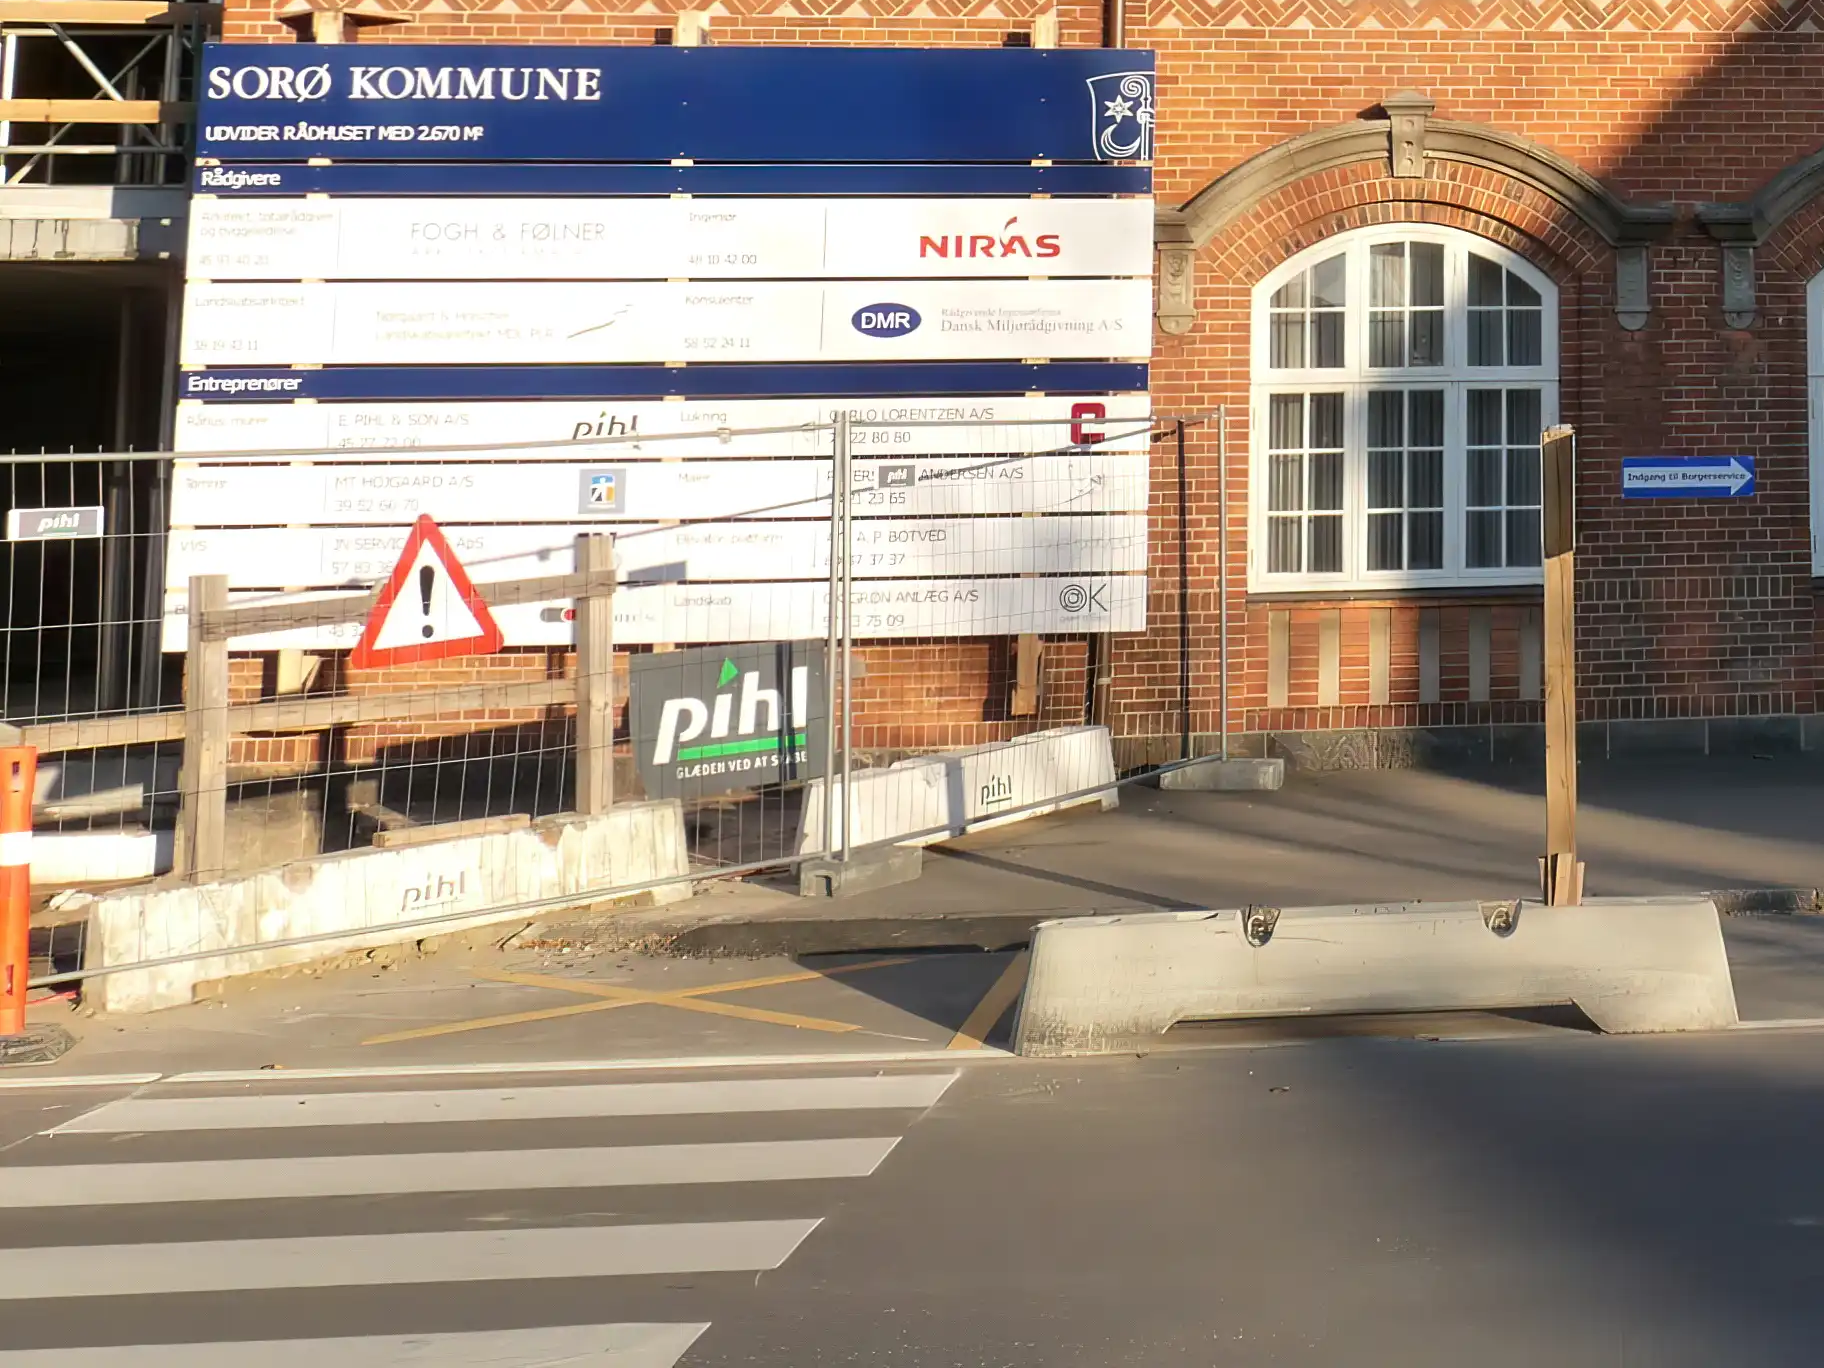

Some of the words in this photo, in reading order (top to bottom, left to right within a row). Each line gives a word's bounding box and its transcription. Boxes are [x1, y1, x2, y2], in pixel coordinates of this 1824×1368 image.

[208, 64, 332, 103] SORØ
[349, 66, 602, 101] KOMMUNE
[205, 126, 280, 142] UDVIDER
[283, 121, 375, 142] RÅDHUSET
[378, 126, 414, 142] MED
[417, 126, 459, 142] 2.670
[201, 168, 281, 189] Rådgivere
[411, 223, 478, 241] FOGH
[492, 222, 507, 241] &
[520, 222, 605, 241] FØLNER
[861, 312, 911, 330] DMR
[941, 320, 982, 333] Dansk
[187, 375, 302, 396] Entreprenører
[444, 414, 470, 426] A/S
[681, 411, 728, 424] Lukning
[882, 408, 964, 421] LORENTZEN
[969, 407, 995, 420] A/S
[573, 411, 638, 440] pihl
[999, 466, 1024, 480] A/S
[1628, 472, 1666, 483] Indgang
[1669, 472, 1679, 482] til
[37, 512, 79, 533] pihl
[889, 529, 947, 543] BOTVED
[895, 590, 949, 603] ANLÆG
[954, 589, 980, 602] A/S
[653, 658, 808, 765] pihl
[677, 764, 725, 780] GLÆDEN
[728, 758, 751, 772] VED
[754, 755, 768, 768] AT
[981, 774, 1013, 806] pihl
[402, 871, 465, 912] pihl
